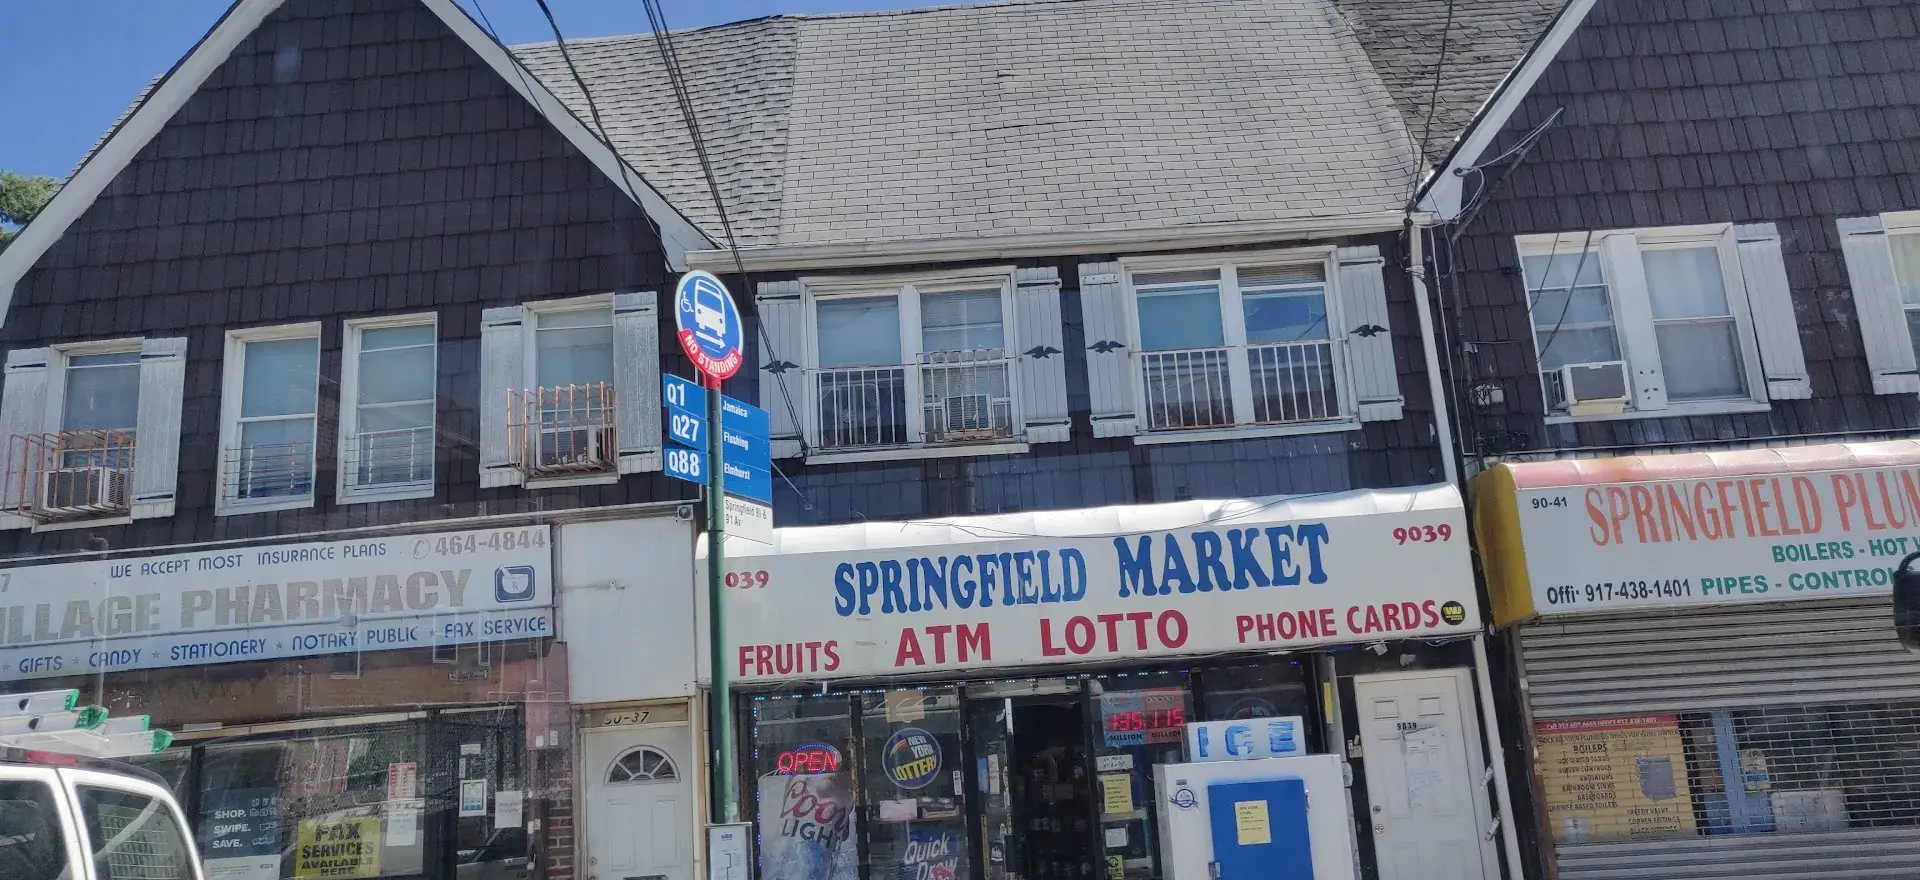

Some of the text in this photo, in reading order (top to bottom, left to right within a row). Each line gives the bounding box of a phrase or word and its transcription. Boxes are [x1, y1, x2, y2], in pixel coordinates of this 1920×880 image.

[685, 334, 738, 374] NO STANDING
[667, 383, 685, 406] Q1
[723, 401, 748, 417] Jamaica
[672, 415, 699, 442] Q27
[723, 431, 749, 451] Flushing
[669, 450, 700, 477] Q88
[724, 462, 750, 480] Elmhurst
[726, 499, 755, 516] Springfield
[1532, 496, 1568, 509] 90-41
[1585, 477, 1823, 546] SPRINGFIELD
[726, 513, 741, 527] 91 Av
[434, 529, 546, 556] 464-4844
[1392, 523, 1452, 546] 9039
[110, 542, 387, 579] WE ACCEPT MOST INSURANCE PLANS
[1772, 540, 1855, 563] BOILERS
[1868, 537, 1908, 557] HOT
[725, 570, 770, 590] 039
[834, 522, 1329, 617] SPRINGFIELD MARKET
[1585, 579, 1691, 602] 917-438-1401
[1701, 575, 1769, 597] PIPES
[181, 568, 473, 628] PHARMACY
[19, 615, 546, 674] GIFTS CANDY STATIONERY NOTARY PUBLIC FAX SERVICE
[739, 600, 1440, 677] FRUITS ATM LOTTO PHONE CARDS
[1110, 733, 1143, 742] MILLION
[1397, 722, 1417, 731] 9039
[908, 735, 927, 746] NEW
[1197, 720, 1297, 758] ICE
[1573, 743, 1607, 754] BOILERS
[777, 751, 838, 773] OPEN
[911, 743, 934, 759] YORK
[892, 755, 937, 781] LOTTERY
[214, 810, 247, 820] SHOP.
[213, 823, 252, 835] SWIPE.
[315, 822, 361, 841] FAX
[212, 839, 243, 849] SAVE.
[302, 841, 374, 859] SERVICES
[904, 832, 950, 865] Quick
